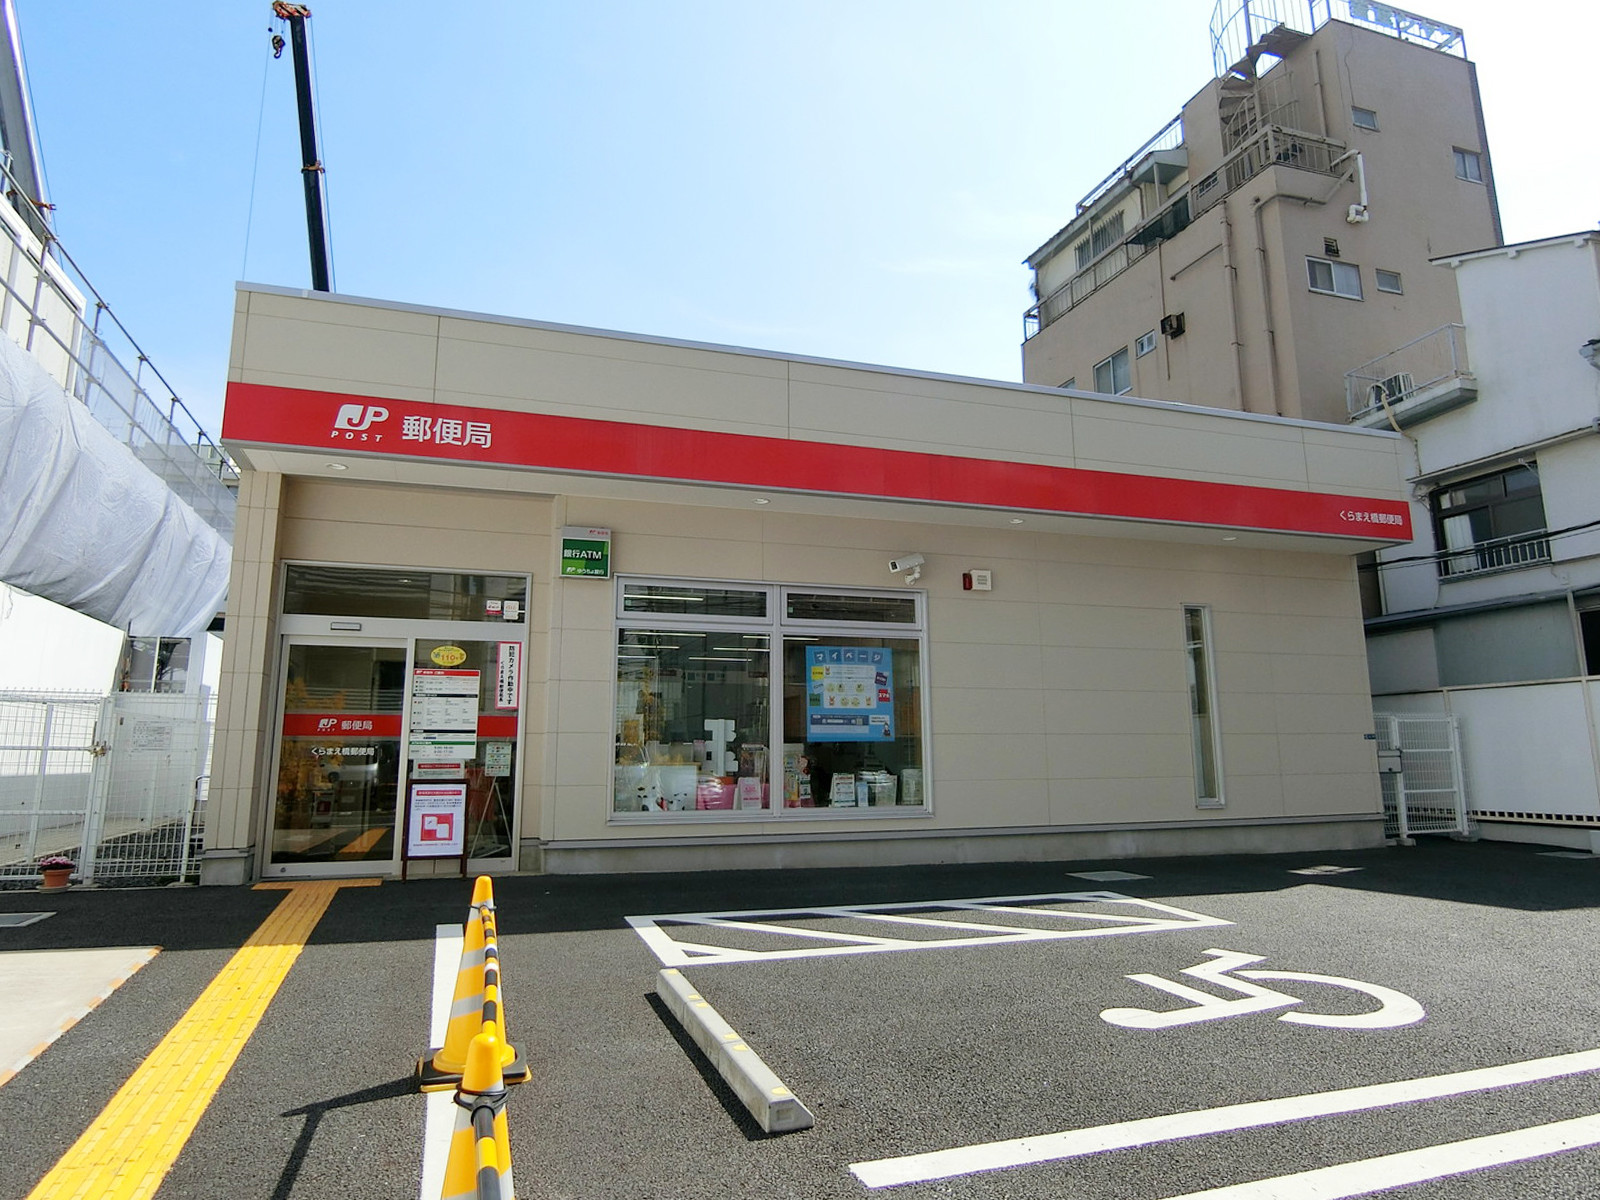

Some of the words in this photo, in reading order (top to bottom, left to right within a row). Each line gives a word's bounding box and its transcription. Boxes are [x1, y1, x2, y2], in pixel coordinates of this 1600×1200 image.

[331, 431, 383, 443] POST
[402, 415, 493, 449] 郵便局
[1339, 510, 1402, 525] くらまえ橋郵便局
[564, 549, 602, 560] 銀行ATM
[341, 720, 373, 731] 郵便局
[311, 746, 375, 756] くらまえ橋郵便局
